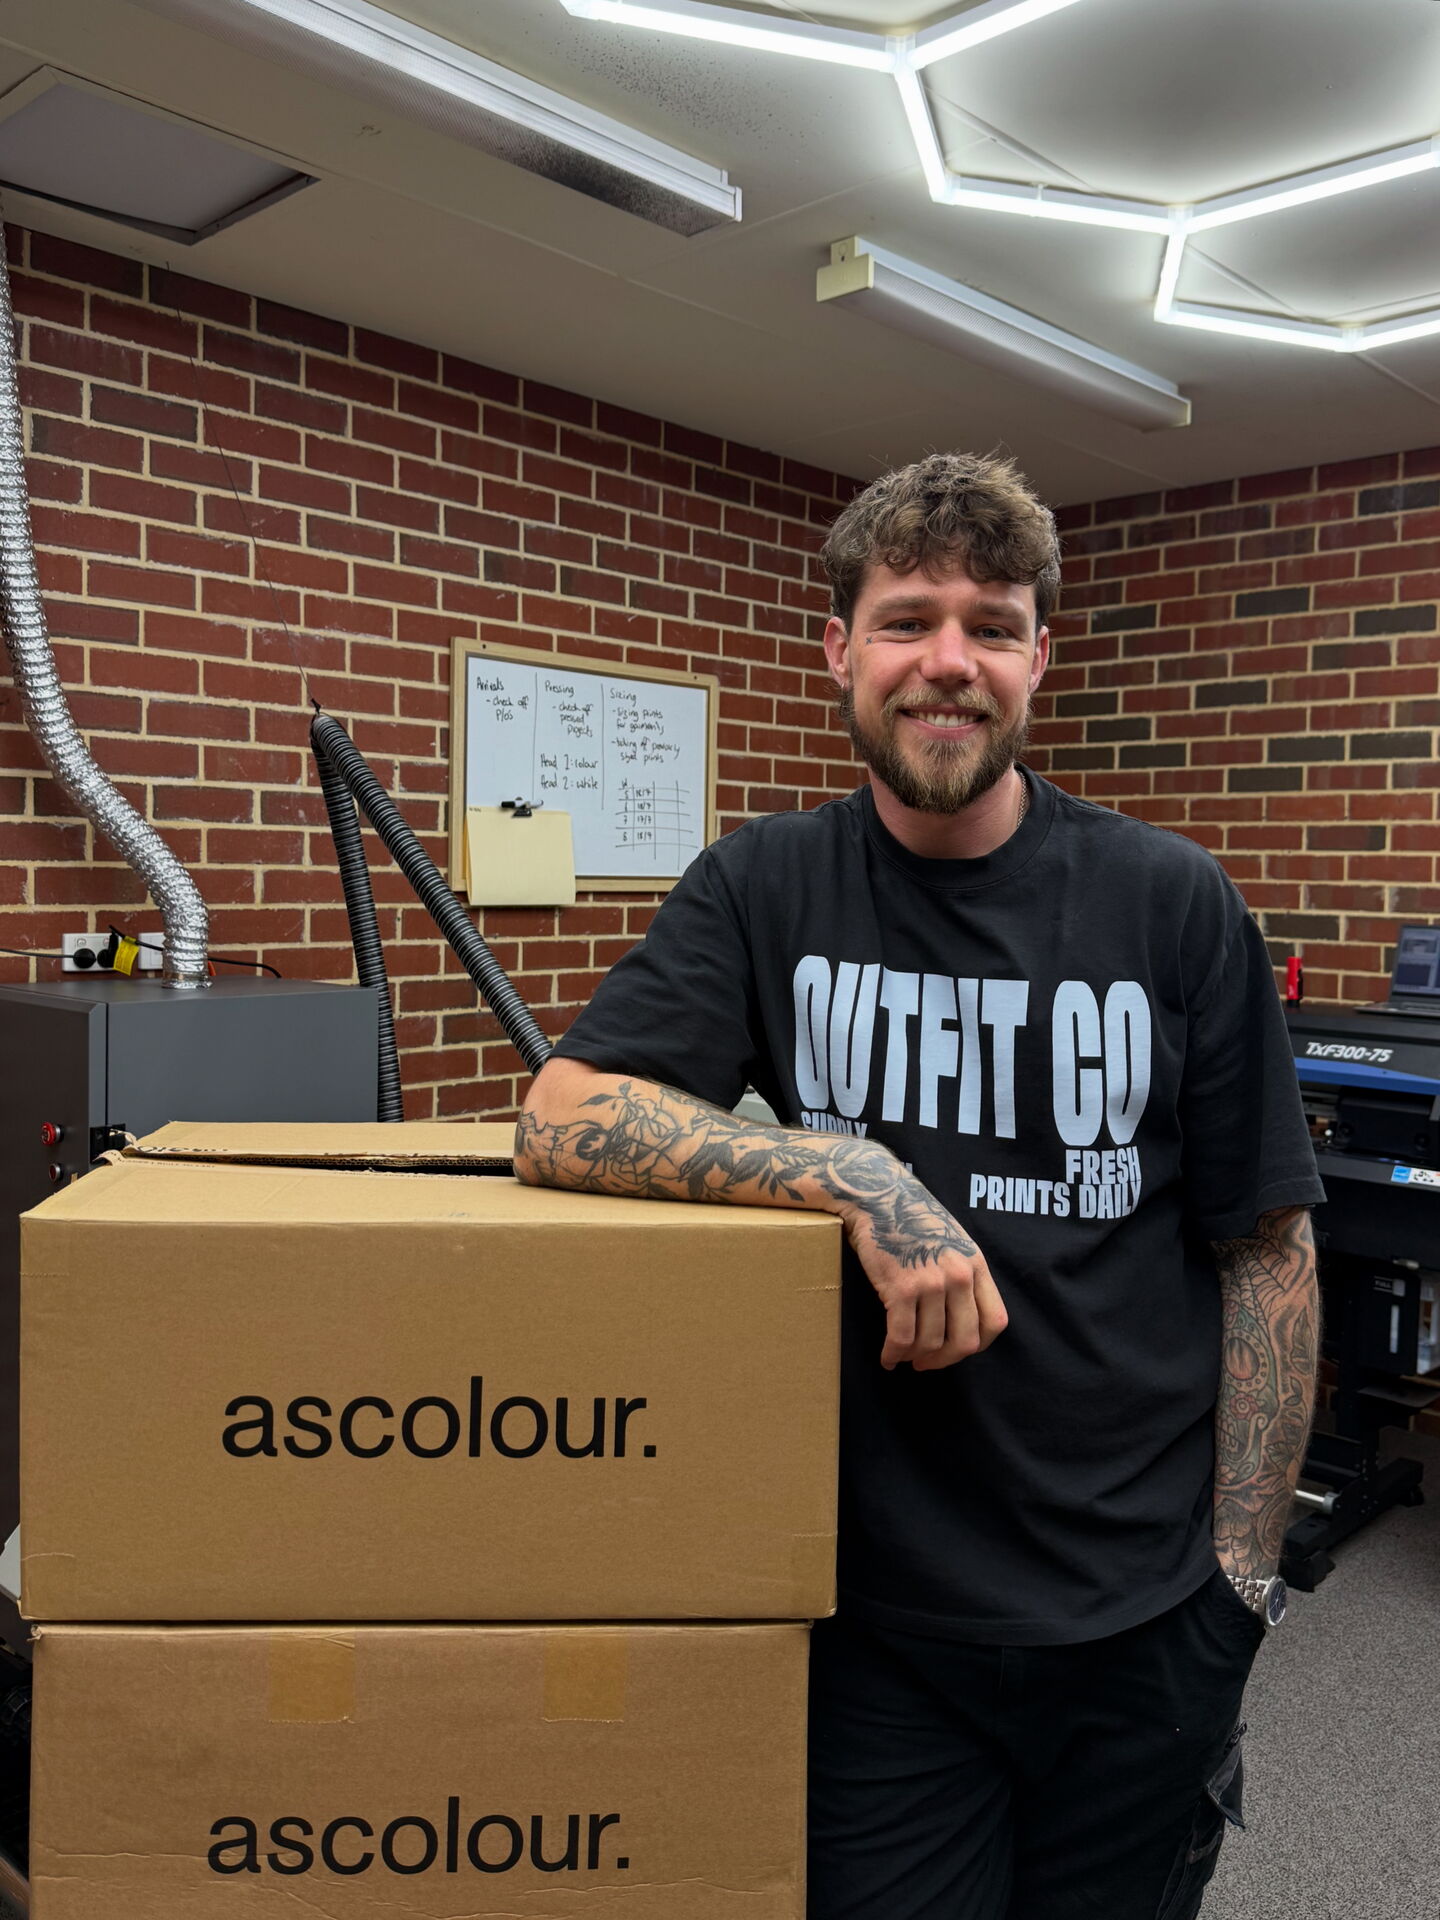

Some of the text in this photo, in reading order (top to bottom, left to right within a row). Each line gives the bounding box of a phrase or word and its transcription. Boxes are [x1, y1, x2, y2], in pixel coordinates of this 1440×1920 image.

[476, 676, 504, 691] Arrivals
[545, 680, 575, 698] Pressing
[610, 687, 637, 707] Sizing
[541, 753, 558, 769] Head
[541, 772, 558, 789] Head
[576, 776, 598, 789] white
[793, 955, 1152, 1146] OUTFIT CO
[1065, 1146, 1142, 1185] FRESH
[969, 1174, 1142, 1219] PRINTS DAILY
[221, 1376, 657, 1459] ascolour.
[207, 1796, 630, 1875] ascolour.
